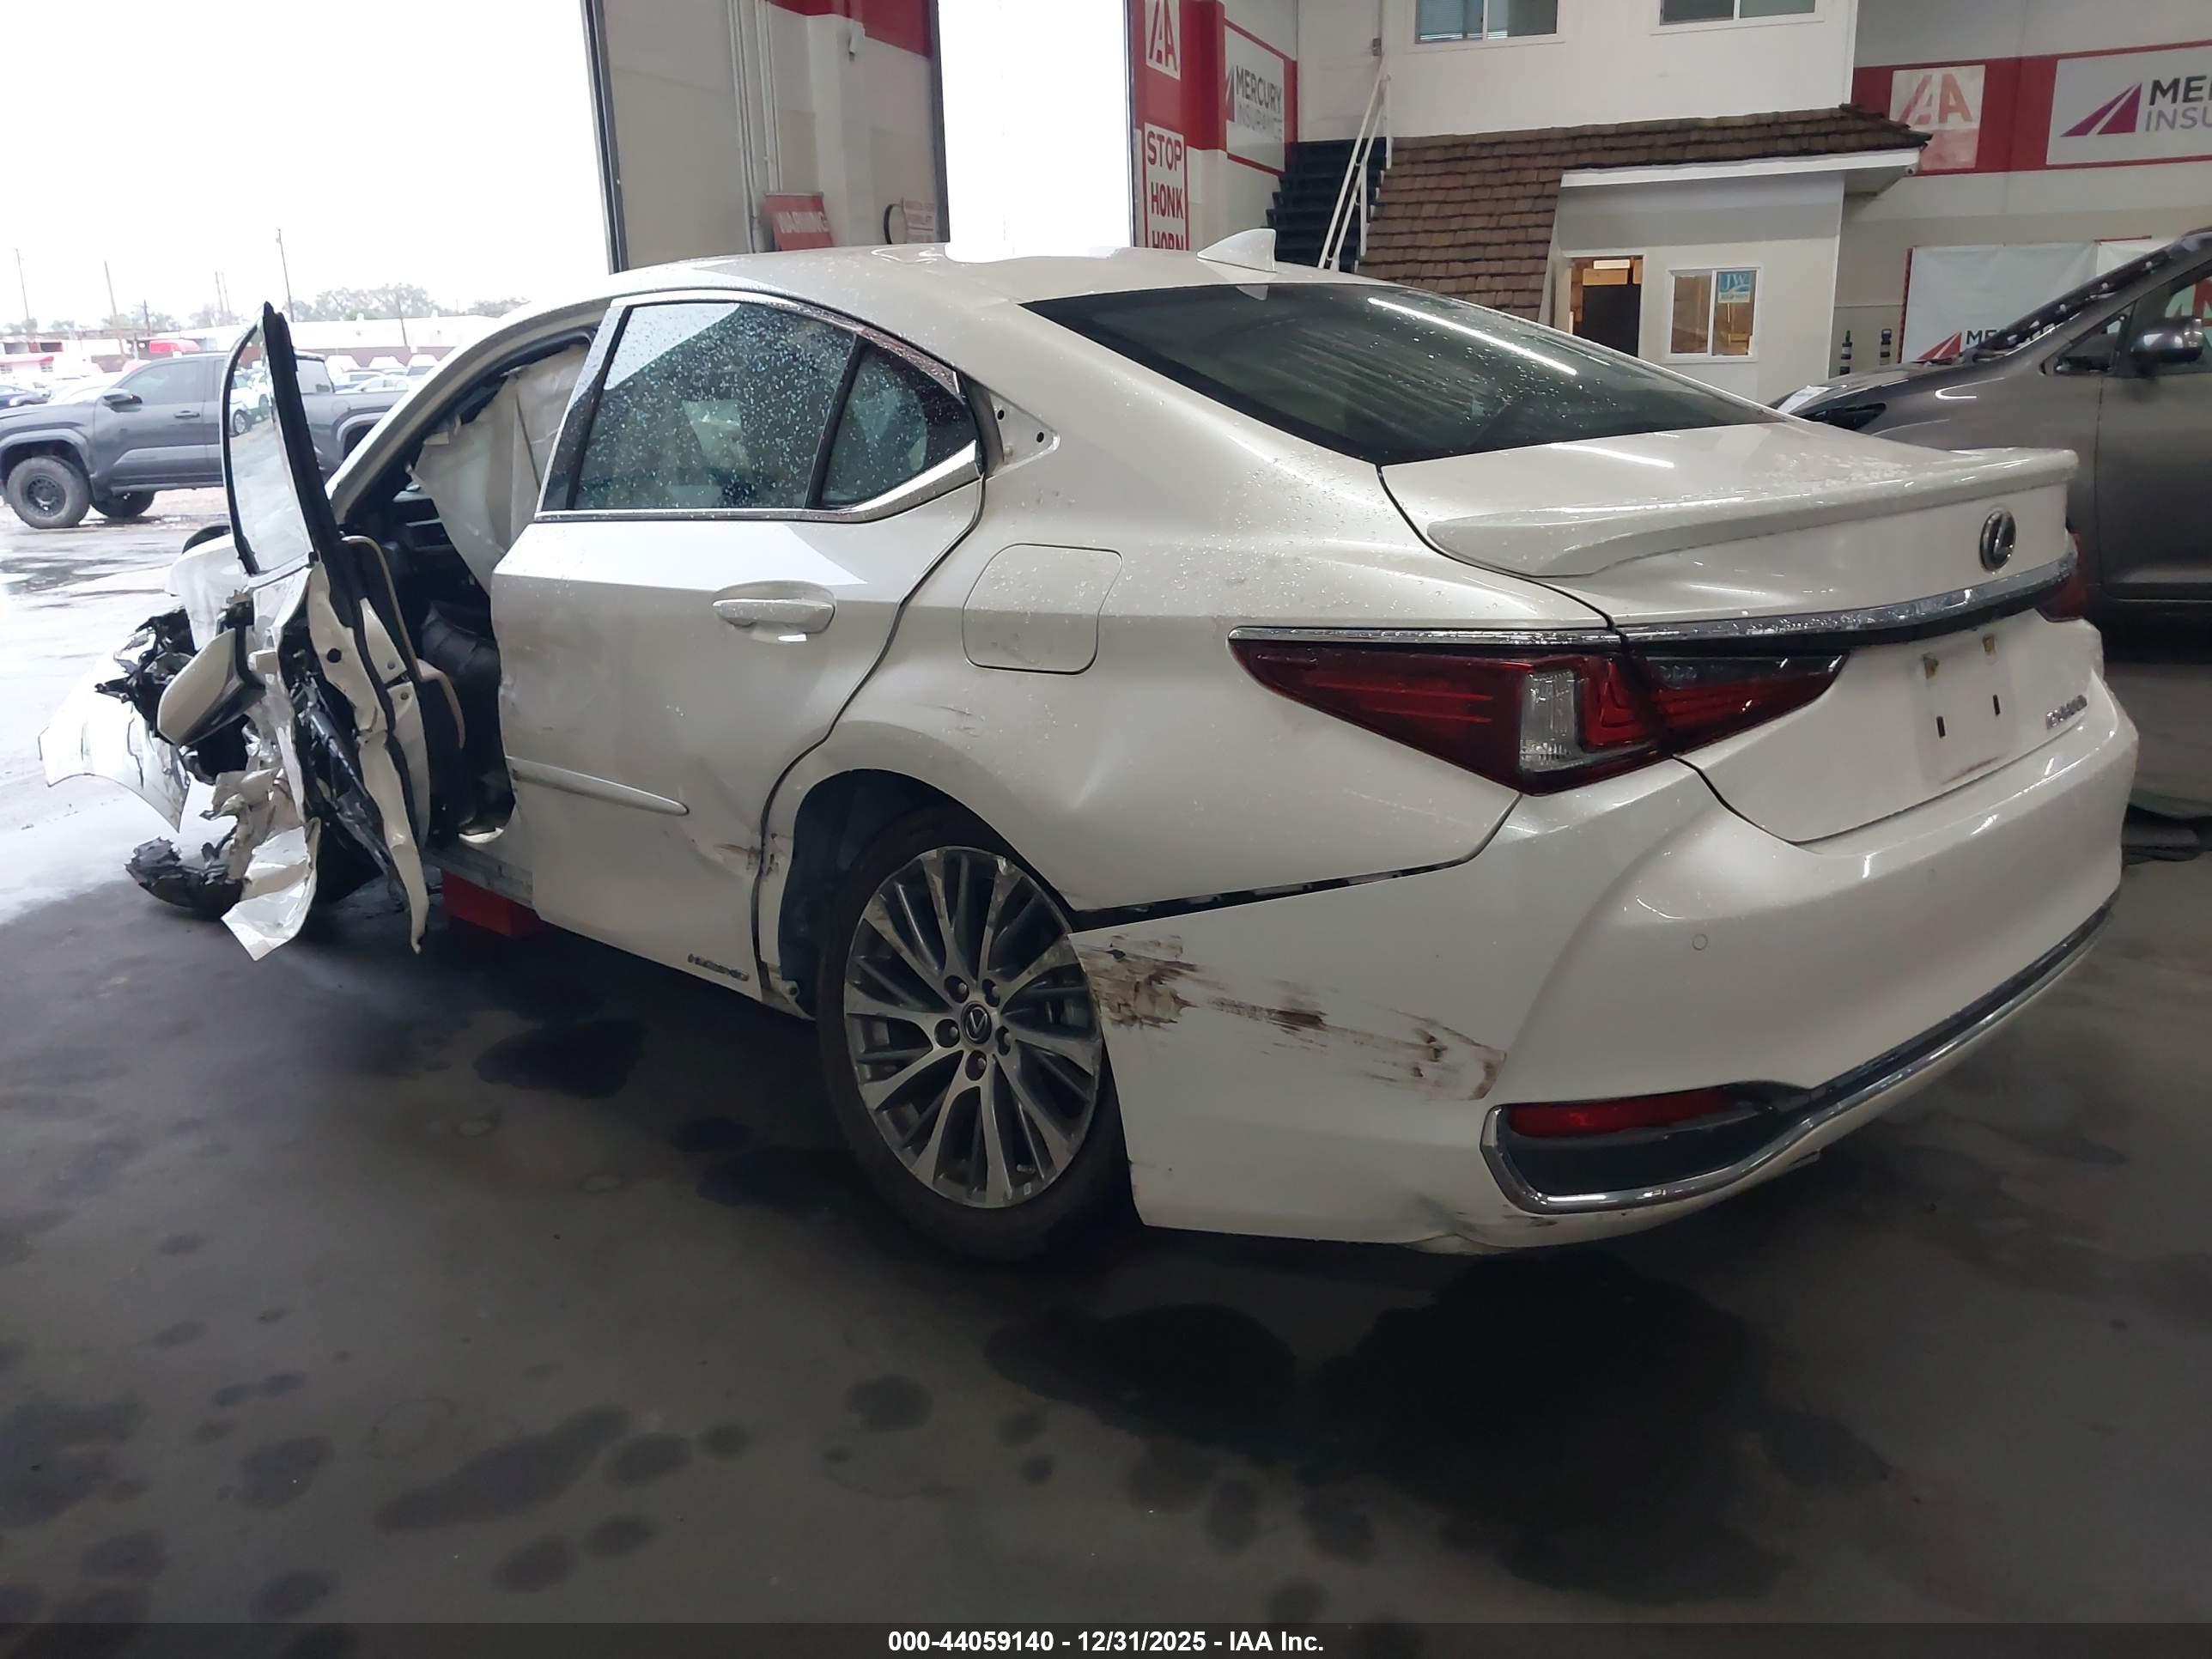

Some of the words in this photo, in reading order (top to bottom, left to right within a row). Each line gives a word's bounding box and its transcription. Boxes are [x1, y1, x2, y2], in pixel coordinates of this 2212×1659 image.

[1236, 64, 1283, 114] MERCURY
[2148, 75, 2212, 106] ME
[1146, 131, 1182, 172] STOP
[1151, 181, 1184, 219] HONK
